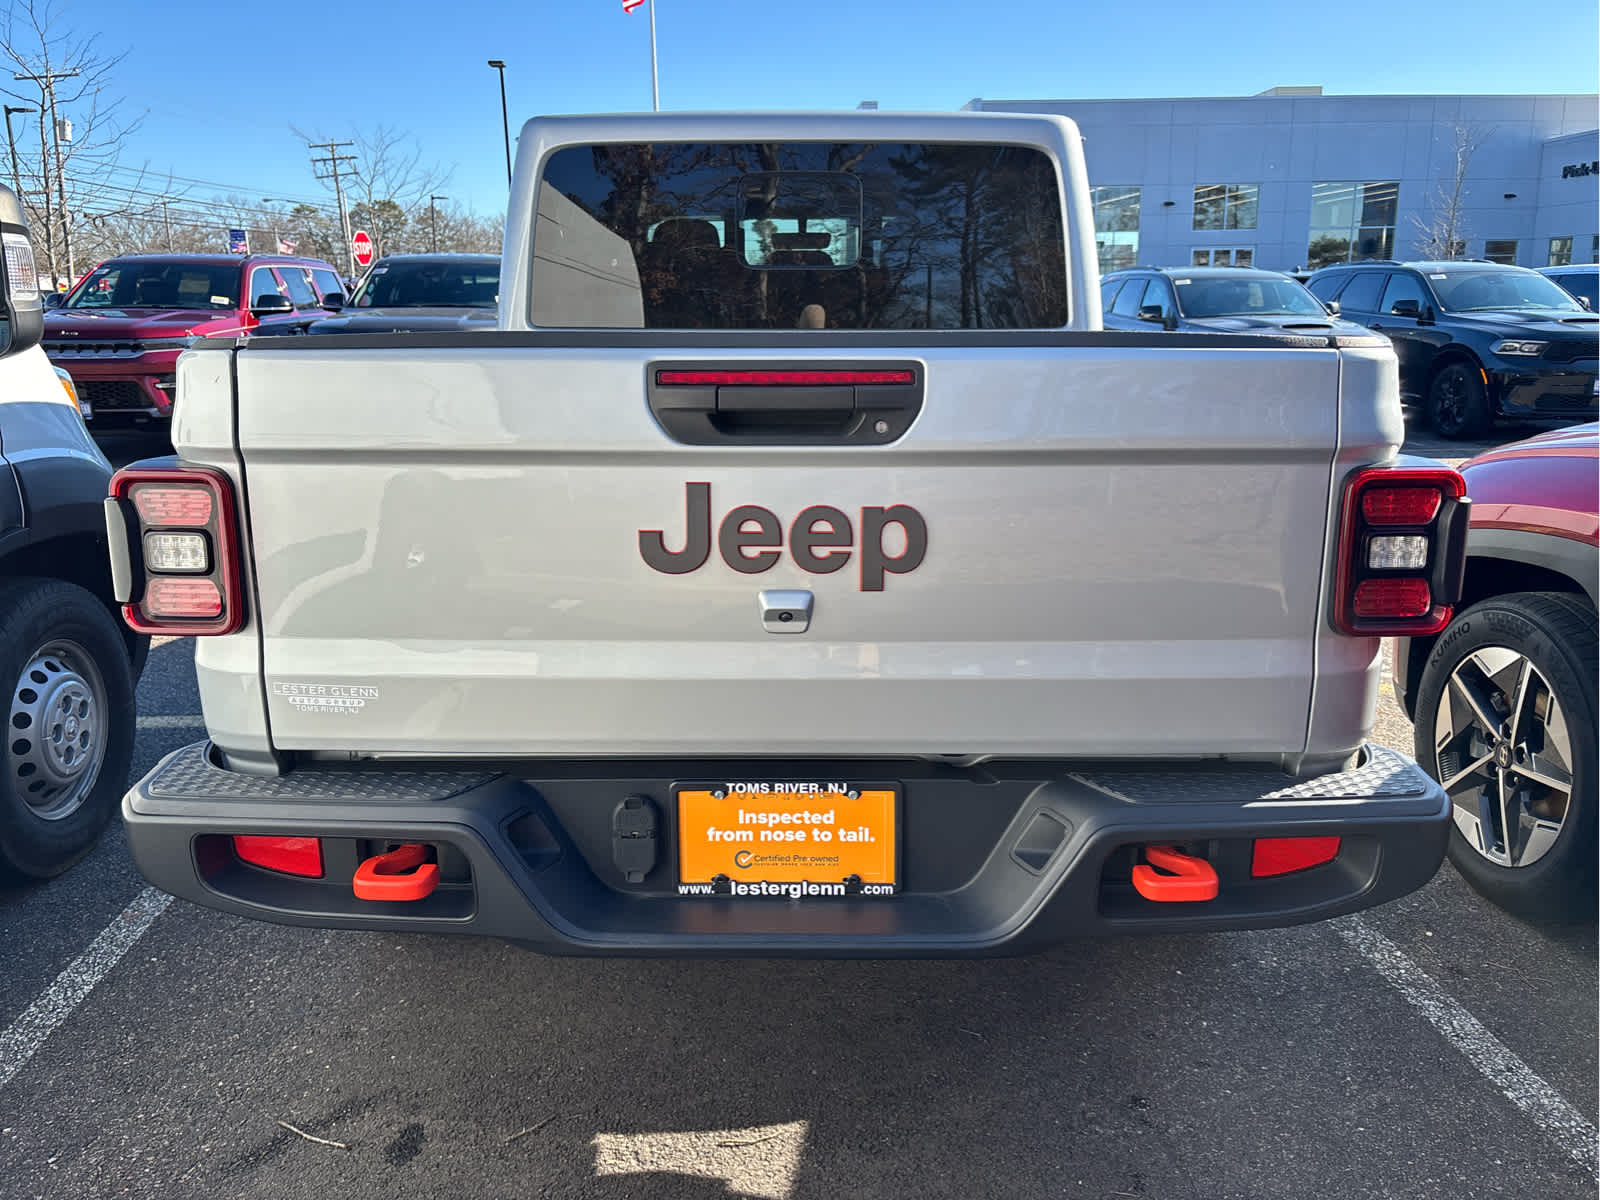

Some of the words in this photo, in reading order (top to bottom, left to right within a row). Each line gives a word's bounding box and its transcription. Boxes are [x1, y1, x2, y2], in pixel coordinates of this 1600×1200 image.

[353, 241, 372, 255] STOP
[638, 481, 928, 592] Jeep
[1430, 622, 1471, 666] KUMHO
[272, 682, 326, 695] LESTER
[331, 687, 379, 697] GLENN
[296, 704, 319, 712] TOMS
[726, 782, 770, 793] TOMS
[774, 782, 823, 794] RIVER,
[827, 782, 848, 794] NJ
[738, 809, 834, 827] Inspected
[706, 827, 753, 842] from
[760, 829, 806, 842] nose
[812, 828, 832, 842] to
[838, 827, 876, 842] tail.
[753, 854, 791, 863] Certified
[678, 884, 715, 895] www.
[730, 881, 846, 899] lesterglenn
[859, 884, 894, 895] .com
